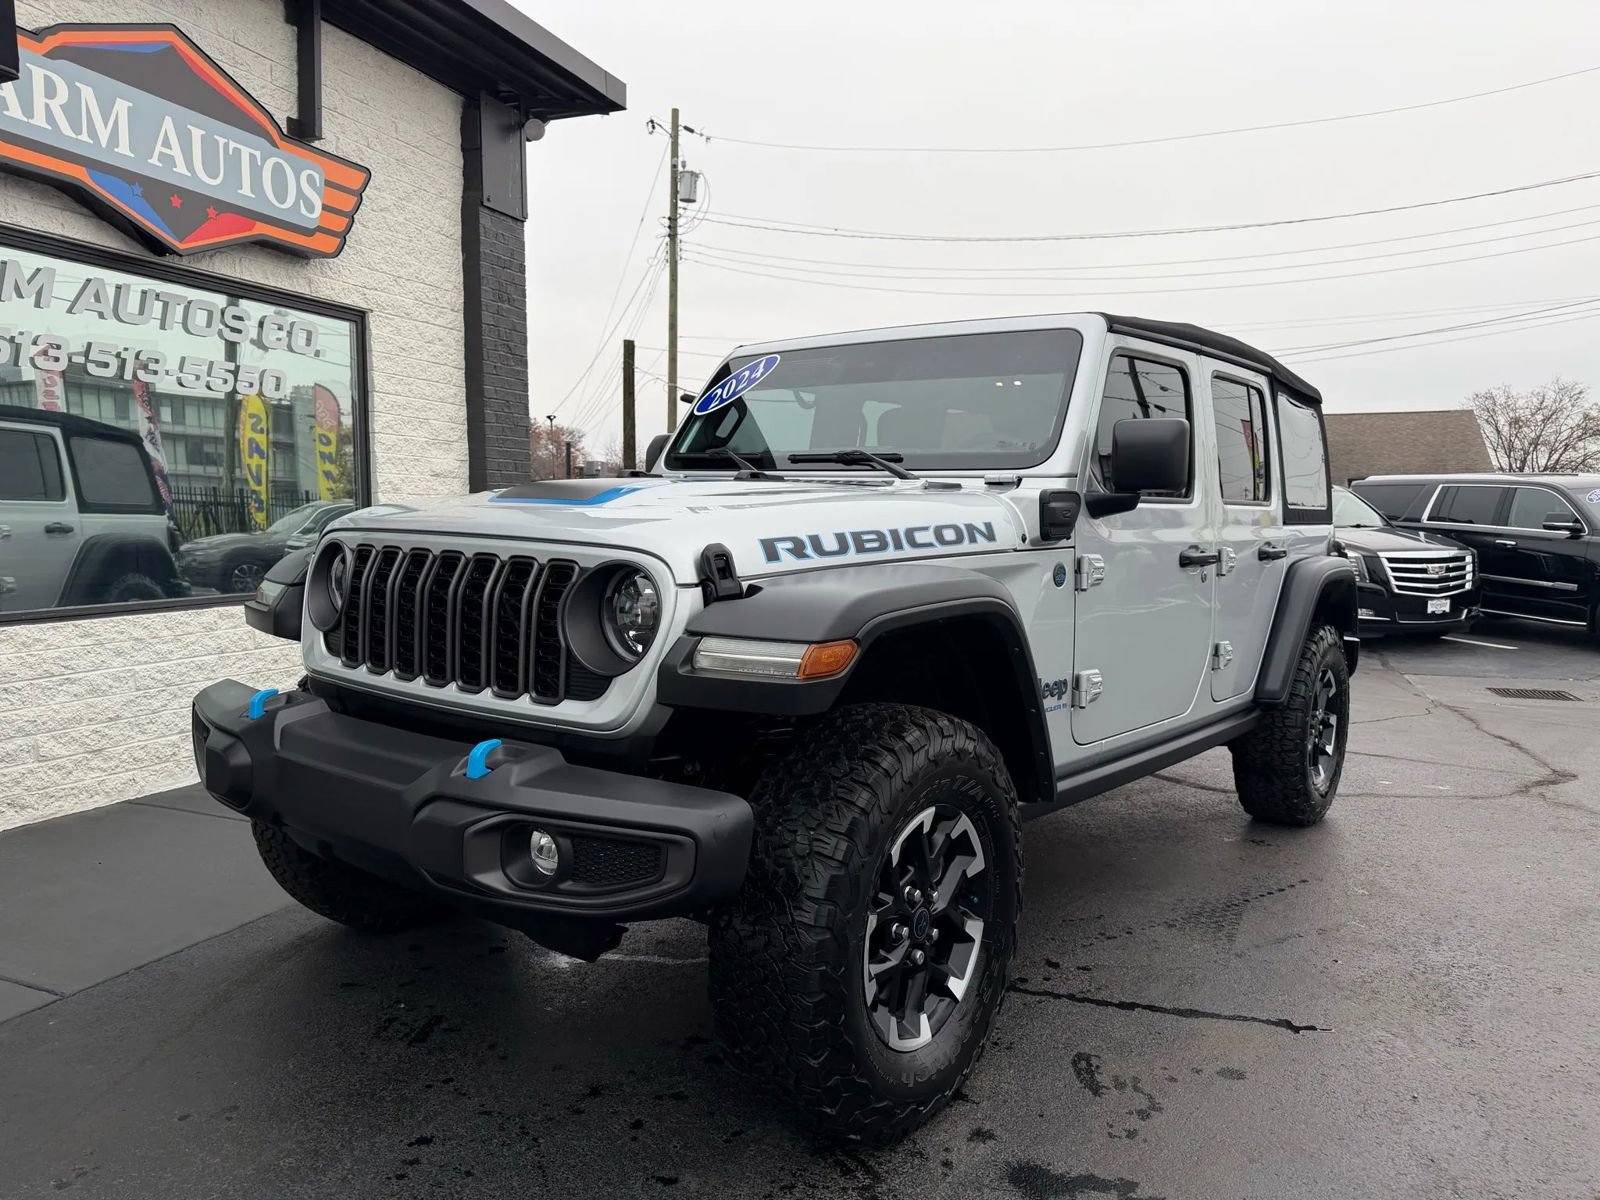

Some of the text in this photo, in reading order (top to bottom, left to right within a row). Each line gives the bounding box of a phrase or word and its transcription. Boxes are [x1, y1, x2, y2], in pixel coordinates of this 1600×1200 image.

[147, 115, 322, 224] AUTOS
[66, 276, 251, 343] AUTOS
[707, 359, 766, 410] 2024
[759, 520, 997, 564] RUBICON
